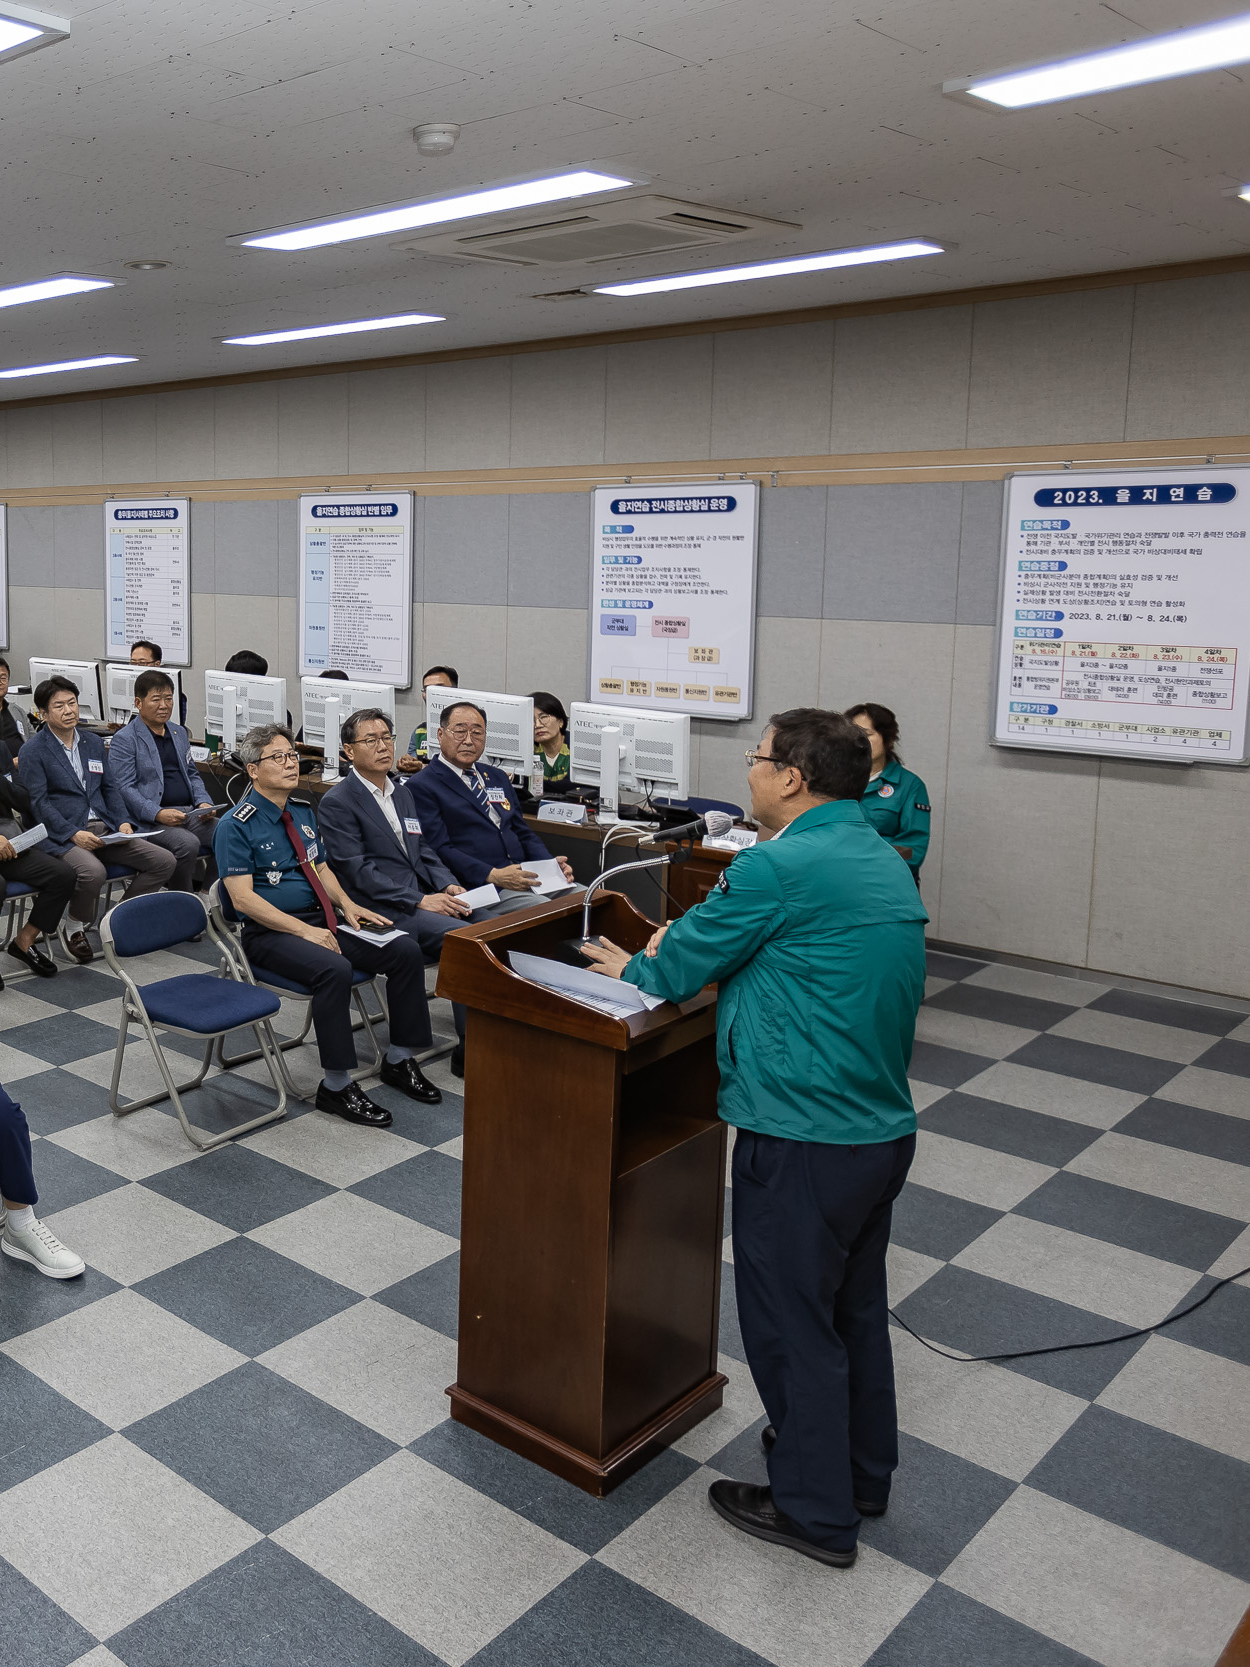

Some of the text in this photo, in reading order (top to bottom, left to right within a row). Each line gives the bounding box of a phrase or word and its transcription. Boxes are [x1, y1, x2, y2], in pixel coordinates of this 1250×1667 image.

[1053, 490, 1103, 504] 2023.
[618, 498, 728, 513] 을지연습 전시종합상황실 운영
[1023, 520, 1062, 530] 연습목적
[1139, 539, 1152, 547] 숙달
[1117, 590, 1131, 598] 숙달
[1017, 611, 1056, 620] 연습기간
[1068, 612, 1092, 620] 2023.
[1095, 613, 1103, 621] 8.
[1106, 613, 1133, 621] 21.(월)
[1159, 615, 1187, 623] 24.(목)
[1016, 627, 1055, 638] 연습일정
[573, 719, 594, 728] ATEC
[1172, 728, 1200, 736] 유관기관
